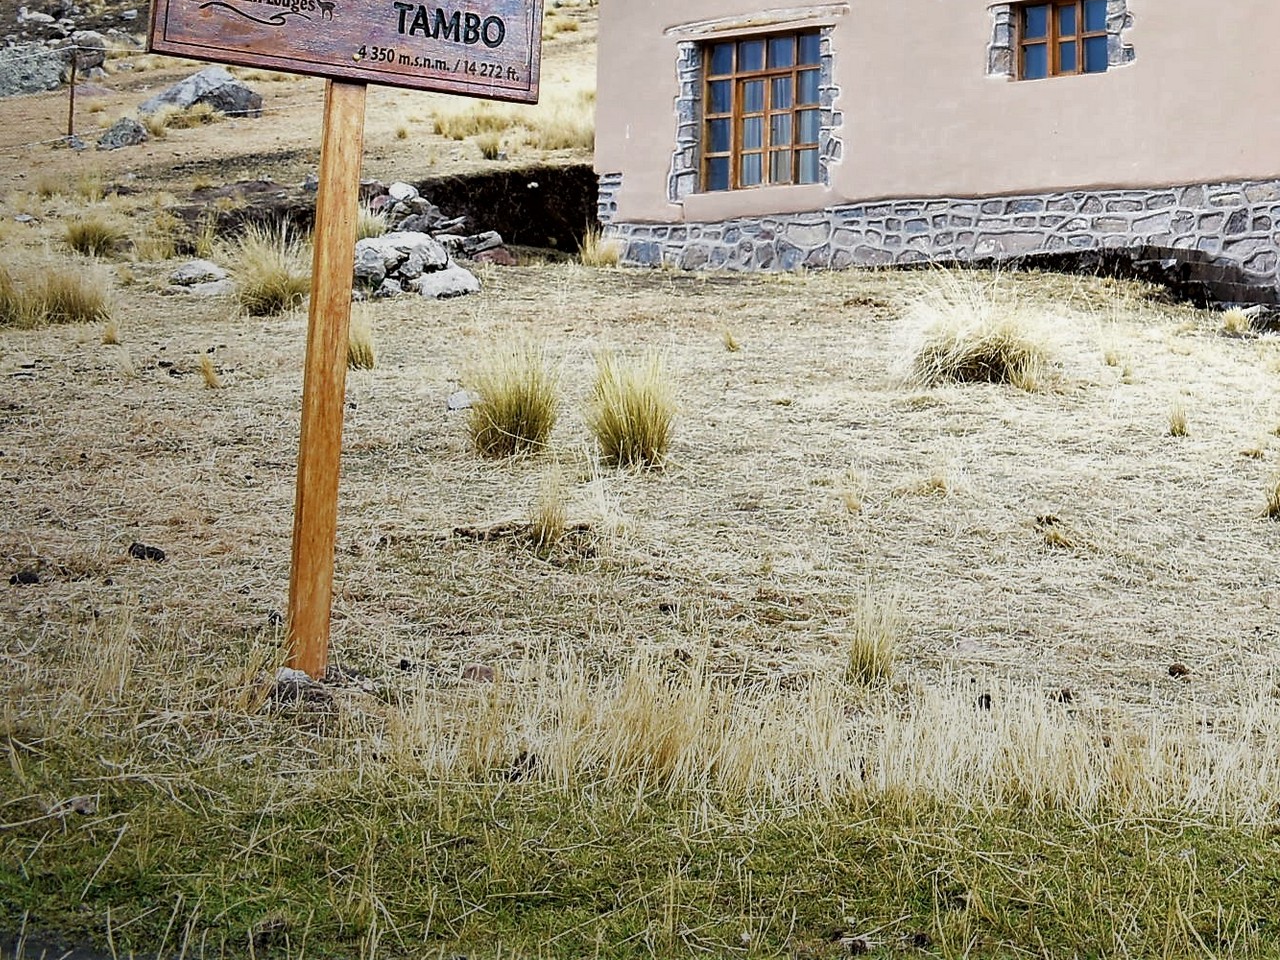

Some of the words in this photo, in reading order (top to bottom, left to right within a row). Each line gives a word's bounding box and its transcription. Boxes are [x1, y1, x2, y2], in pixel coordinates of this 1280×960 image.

[393, 1, 506, 48] TAMBO
[357, 45, 367, 59] 4
[370, 46, 395, 63] 350
[398, 53, 450, 71] m.s.n.m.
[453, 58, 461, 73] /
[463, 60, 477, 76] 14
[480, 62, 503, 79] 272
[506, 66, 520, 82] ft.
